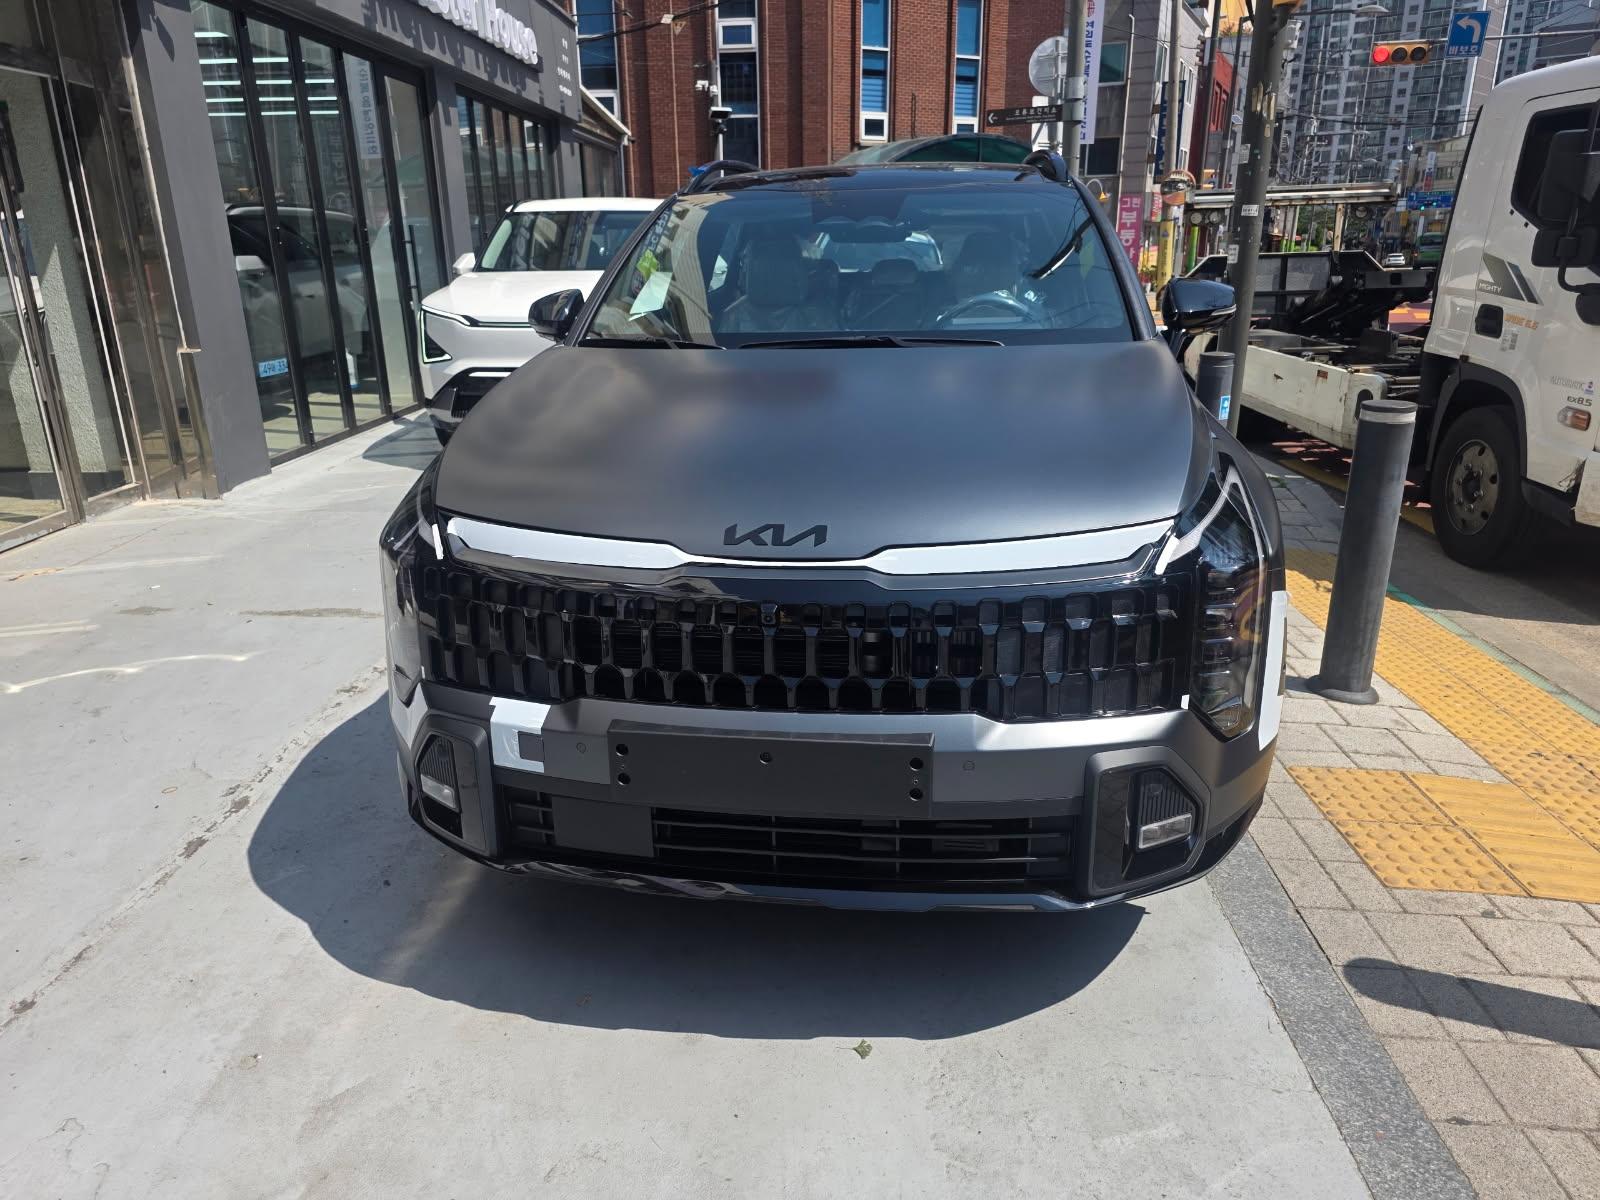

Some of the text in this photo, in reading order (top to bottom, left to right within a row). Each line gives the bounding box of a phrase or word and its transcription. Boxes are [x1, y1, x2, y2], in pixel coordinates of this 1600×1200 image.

[1448, 45, 1479, 56] 비보호
[1479, 282, 1502, 294] MIGHTY
[723, 523, 828, 548] KIA
